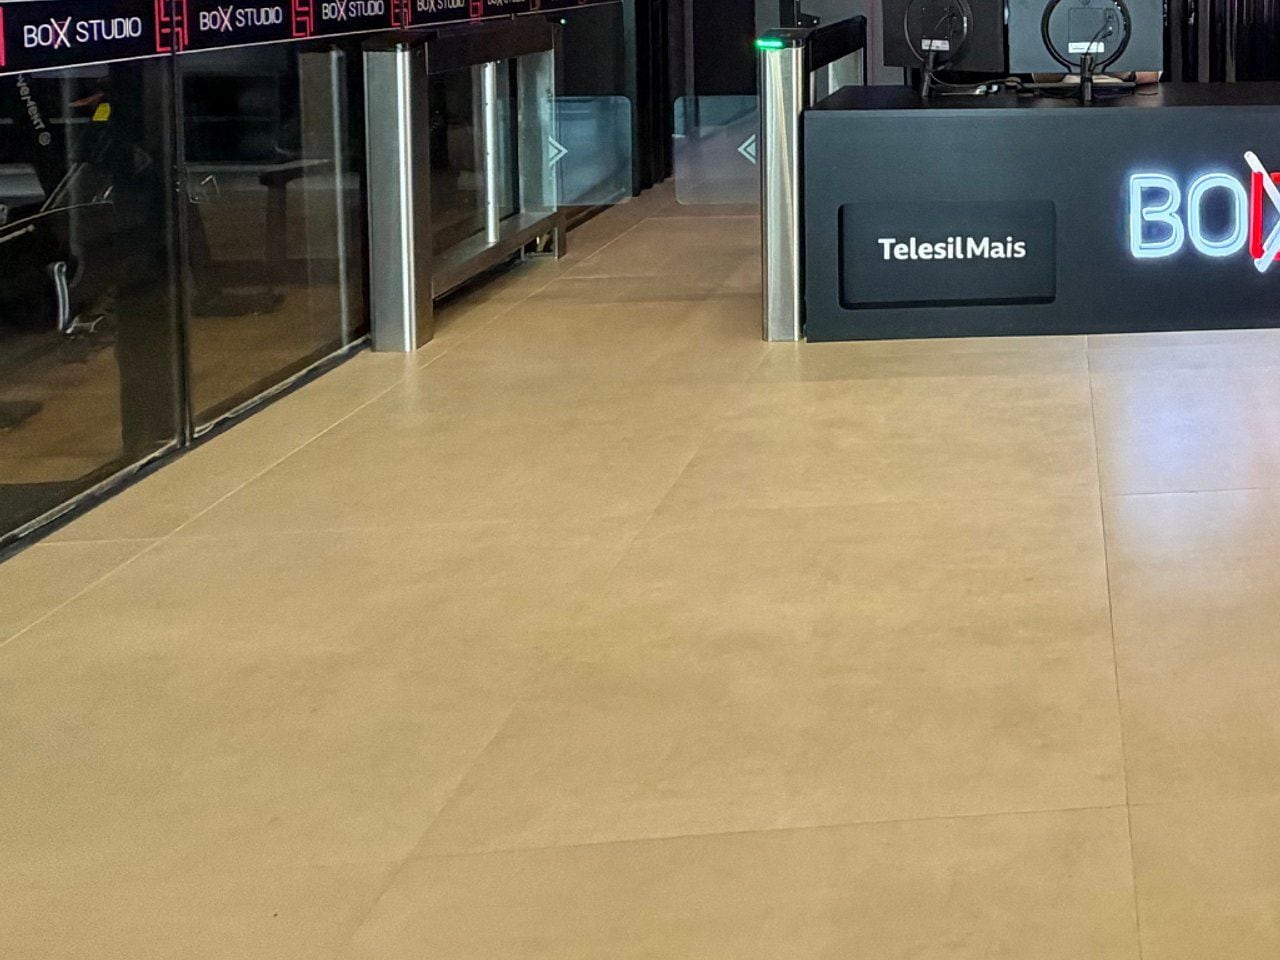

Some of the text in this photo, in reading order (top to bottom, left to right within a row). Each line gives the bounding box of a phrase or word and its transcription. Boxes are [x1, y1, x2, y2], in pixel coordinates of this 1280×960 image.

[199, 5, 282, 32] BOX STUDIO
[348, 0, 385, 18] STUDIO
[23, 16, 142, 49] BOX STUDIO
